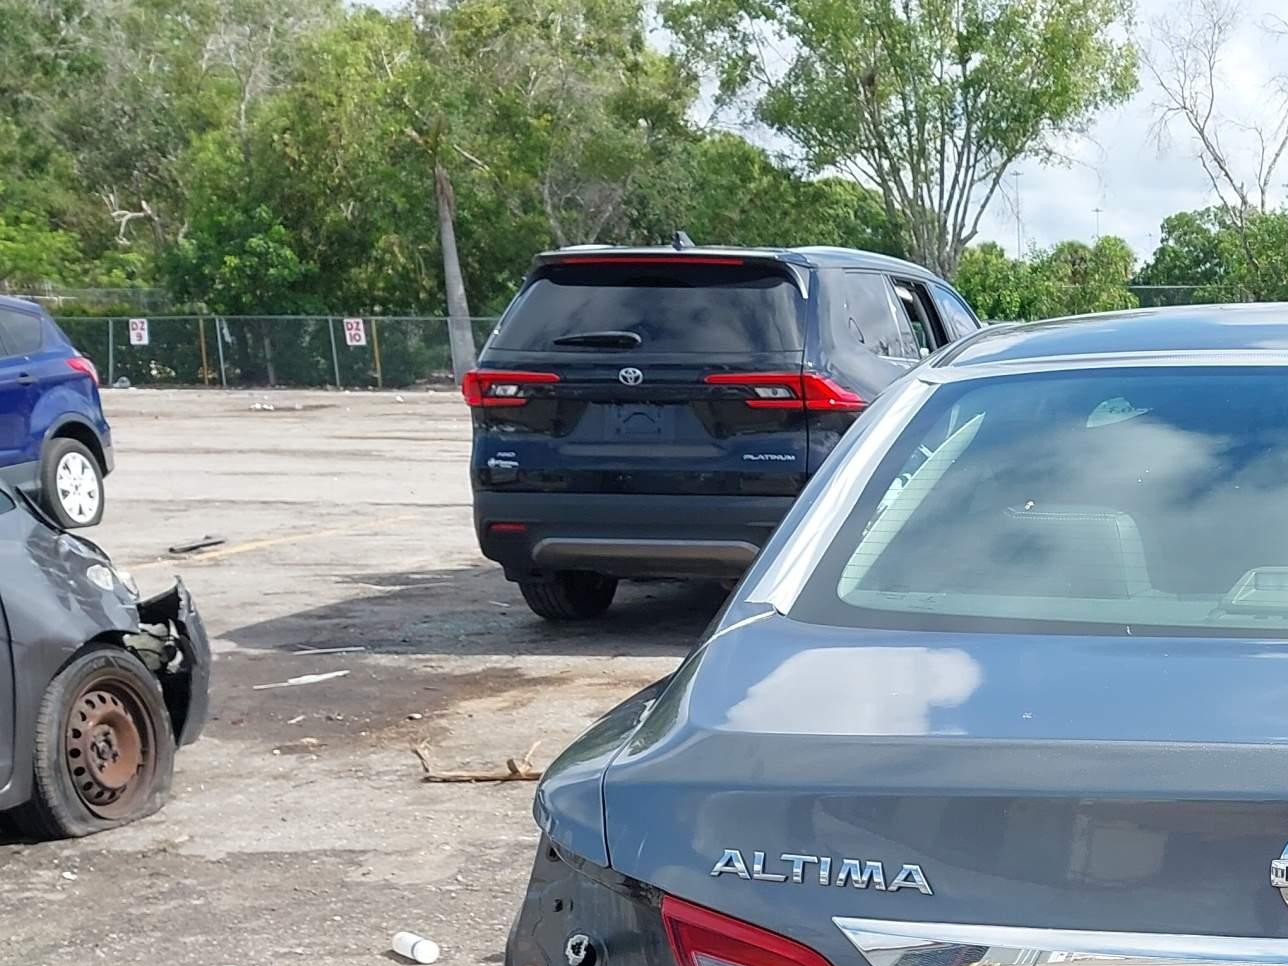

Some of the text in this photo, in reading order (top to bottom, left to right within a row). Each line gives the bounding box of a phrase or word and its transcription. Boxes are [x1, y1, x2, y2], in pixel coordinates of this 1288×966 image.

[131, 321, 145, 331] DZ
[346, 321, 361, 331] DZ
[135, 332, 143, 342] 9
[709, 849, 935, 896] ALTIMA
